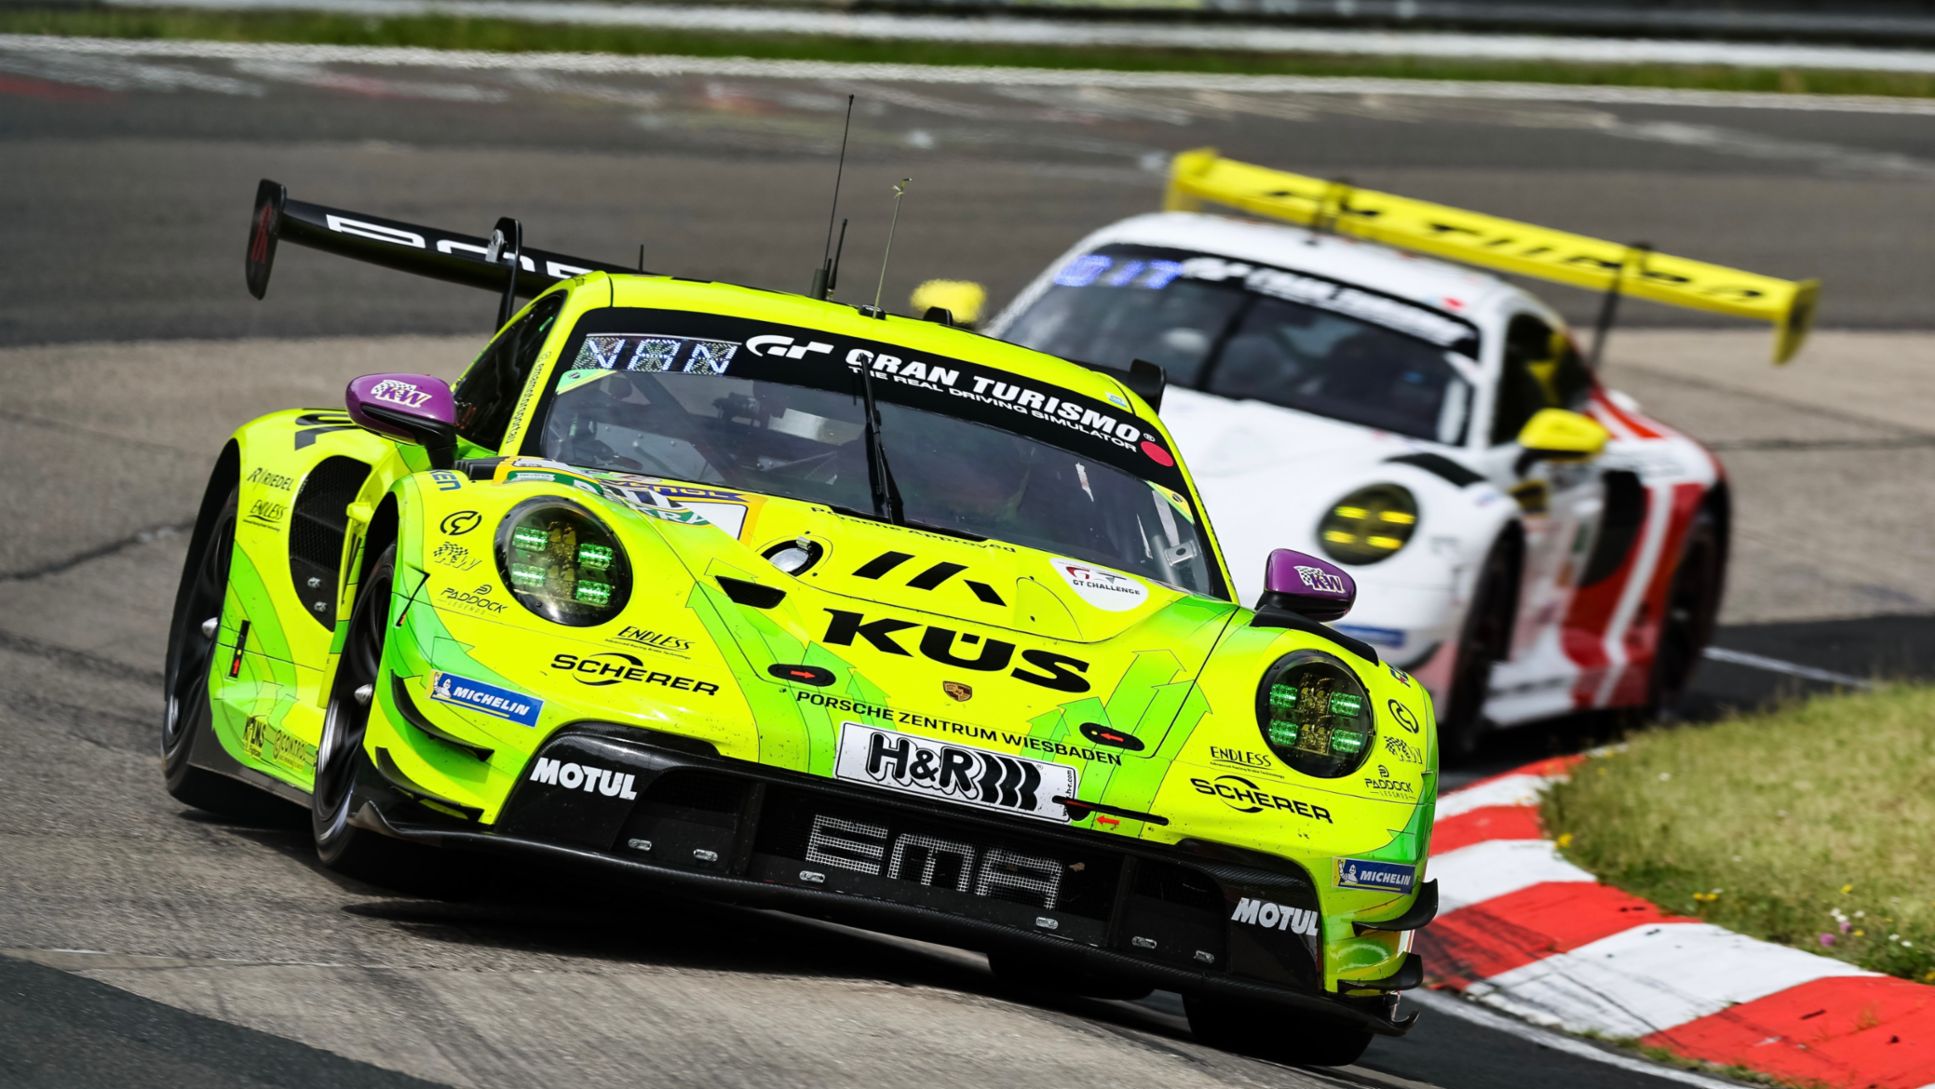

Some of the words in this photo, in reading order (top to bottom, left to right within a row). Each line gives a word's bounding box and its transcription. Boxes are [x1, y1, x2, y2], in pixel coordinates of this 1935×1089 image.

[845, 348, 960, 387] GRAN
[972, 375, 1142, 443] TURISMO
[893, 374, 944, 393] REAL
[948, 387, 1029, 414] DRIVING
[1031, 410, 1138, 453] SIMULATOR
[440, 587, 508, 614] PADDOCK
[1086, 581, 1140, 596] CHALLENGE
[618, 625, 696, 651] ENDLESS
[822, 607, 1091, 694] KÜS
[550, 653, 720, 697] SCHERER
[452, 685, 531, 717] MICHELIN
[796, 691, 895, 722] PORSCHE
[898, 711, 999, 743] ZENTRUM
[1001, 732, 1122, 767] WIESBADEN
[528, 756, 638, 801] MOTUL
[866, 730, 980, 799] H&R
[1209, 745, 1272, 768] ENDLESS
[1189, 777, 1334, 825] SCHERER
[1364, 777, 1414, 794] PADDOCK
[805, 813, 1064, 910] EMA
[1359, 869, 1412, 887] MICHELIN
[1230, 896, 1320, 937] MOTUL
